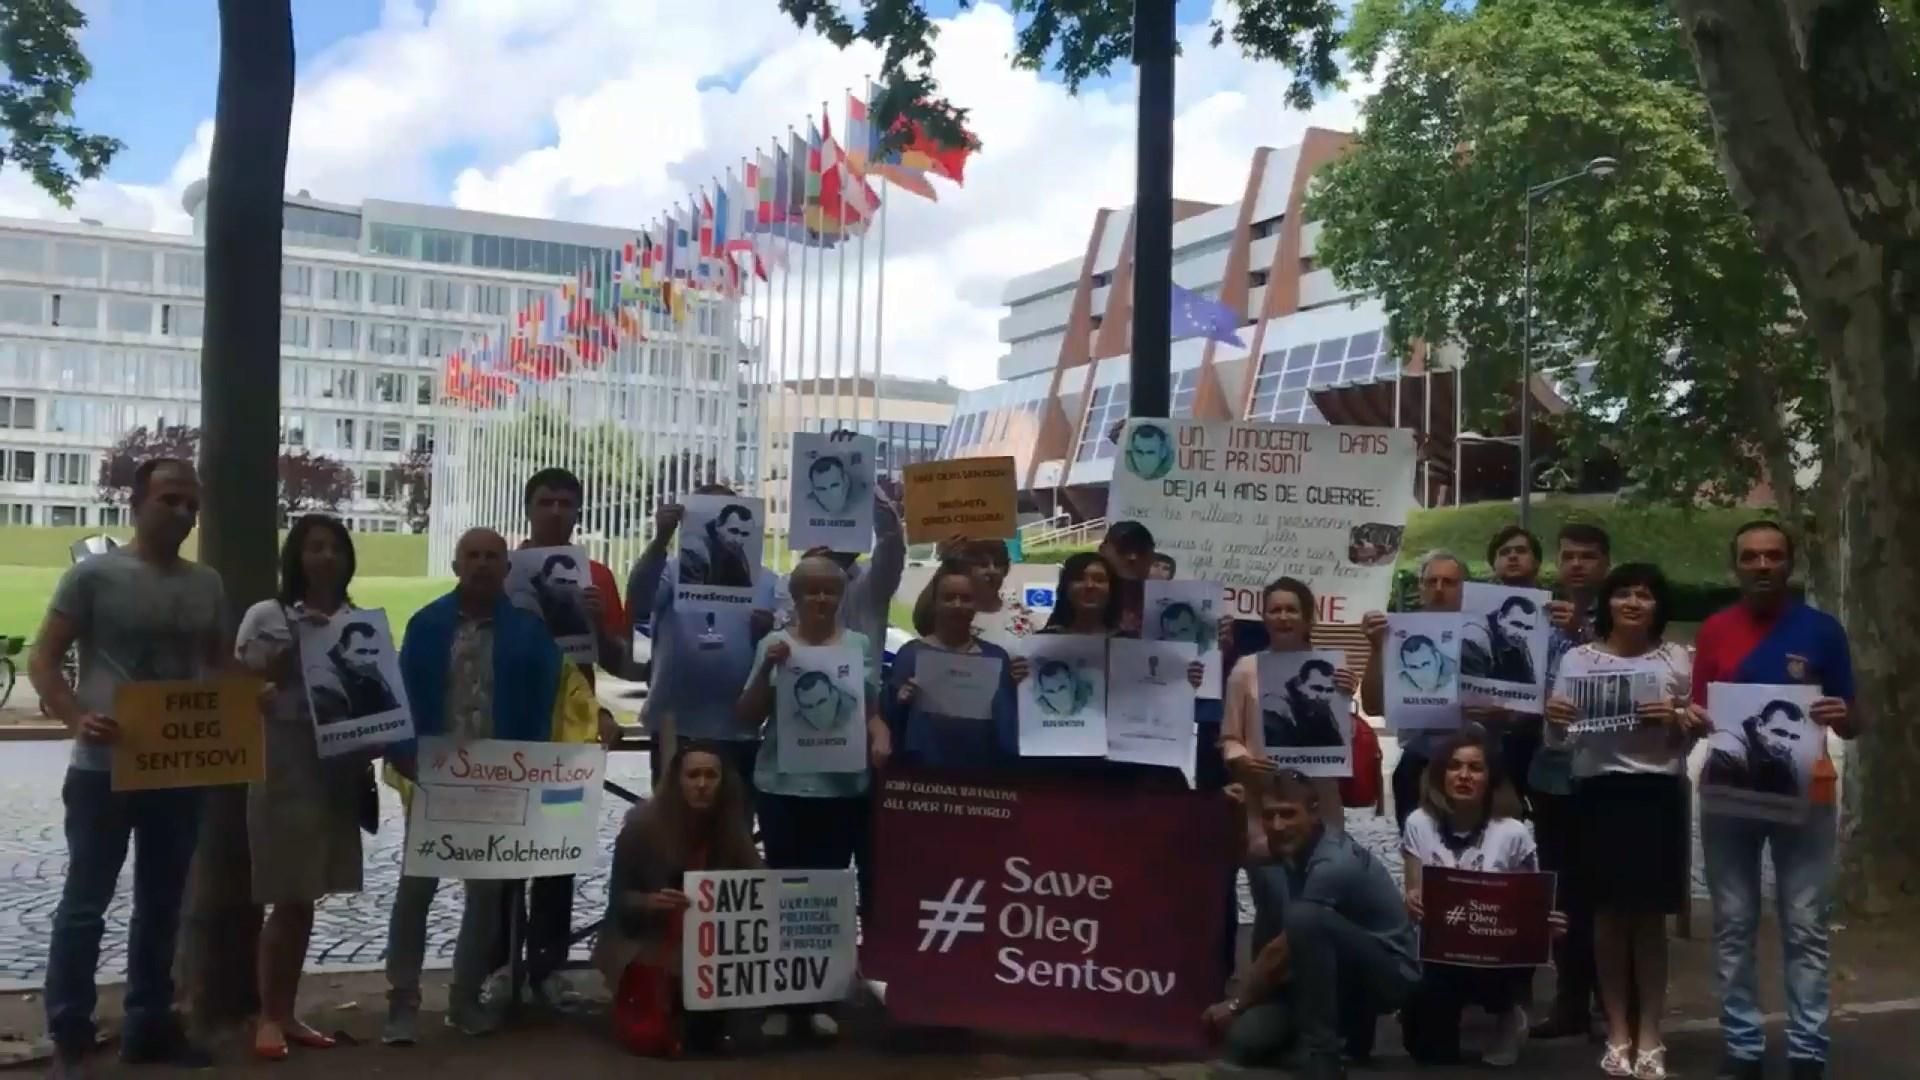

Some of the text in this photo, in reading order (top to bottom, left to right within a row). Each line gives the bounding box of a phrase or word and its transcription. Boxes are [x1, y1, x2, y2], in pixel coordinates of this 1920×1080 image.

[1179, 425, 1204, 447] UN
[1339, 431, 1388, 455] DANS
[1178, 449, 1216, 472] UNE
[1213, 479, 1226, 498] 4
[1233, 482, 1268, 501] ANS
[1275, 484, 1298, 504] DE
[165, 691, 218, 713] FREE
[162, 720, 222, 740] OLEG
[912, 782, 959, 797] GLOBAL
[883, 798, 1010, 819] ALL OVER THE WORLD
[416, 834, 583, 863] #SaveKolchenko
[1000, 855, 1114, 901] Save
[696, 878, 767, 913] SAVE
[1469, 898, 1500, 913] Save
[998, 901, 1099, 955] Oleg
[1467, 923, 1519, 937] Sentsov
[1469, 911, 1498, 926] Oleg
[698, 918, 769, 958] OLEG
[697, 956, 830, 1000] SENTSOV
[994, 945, 1177, 997] Sentsov
